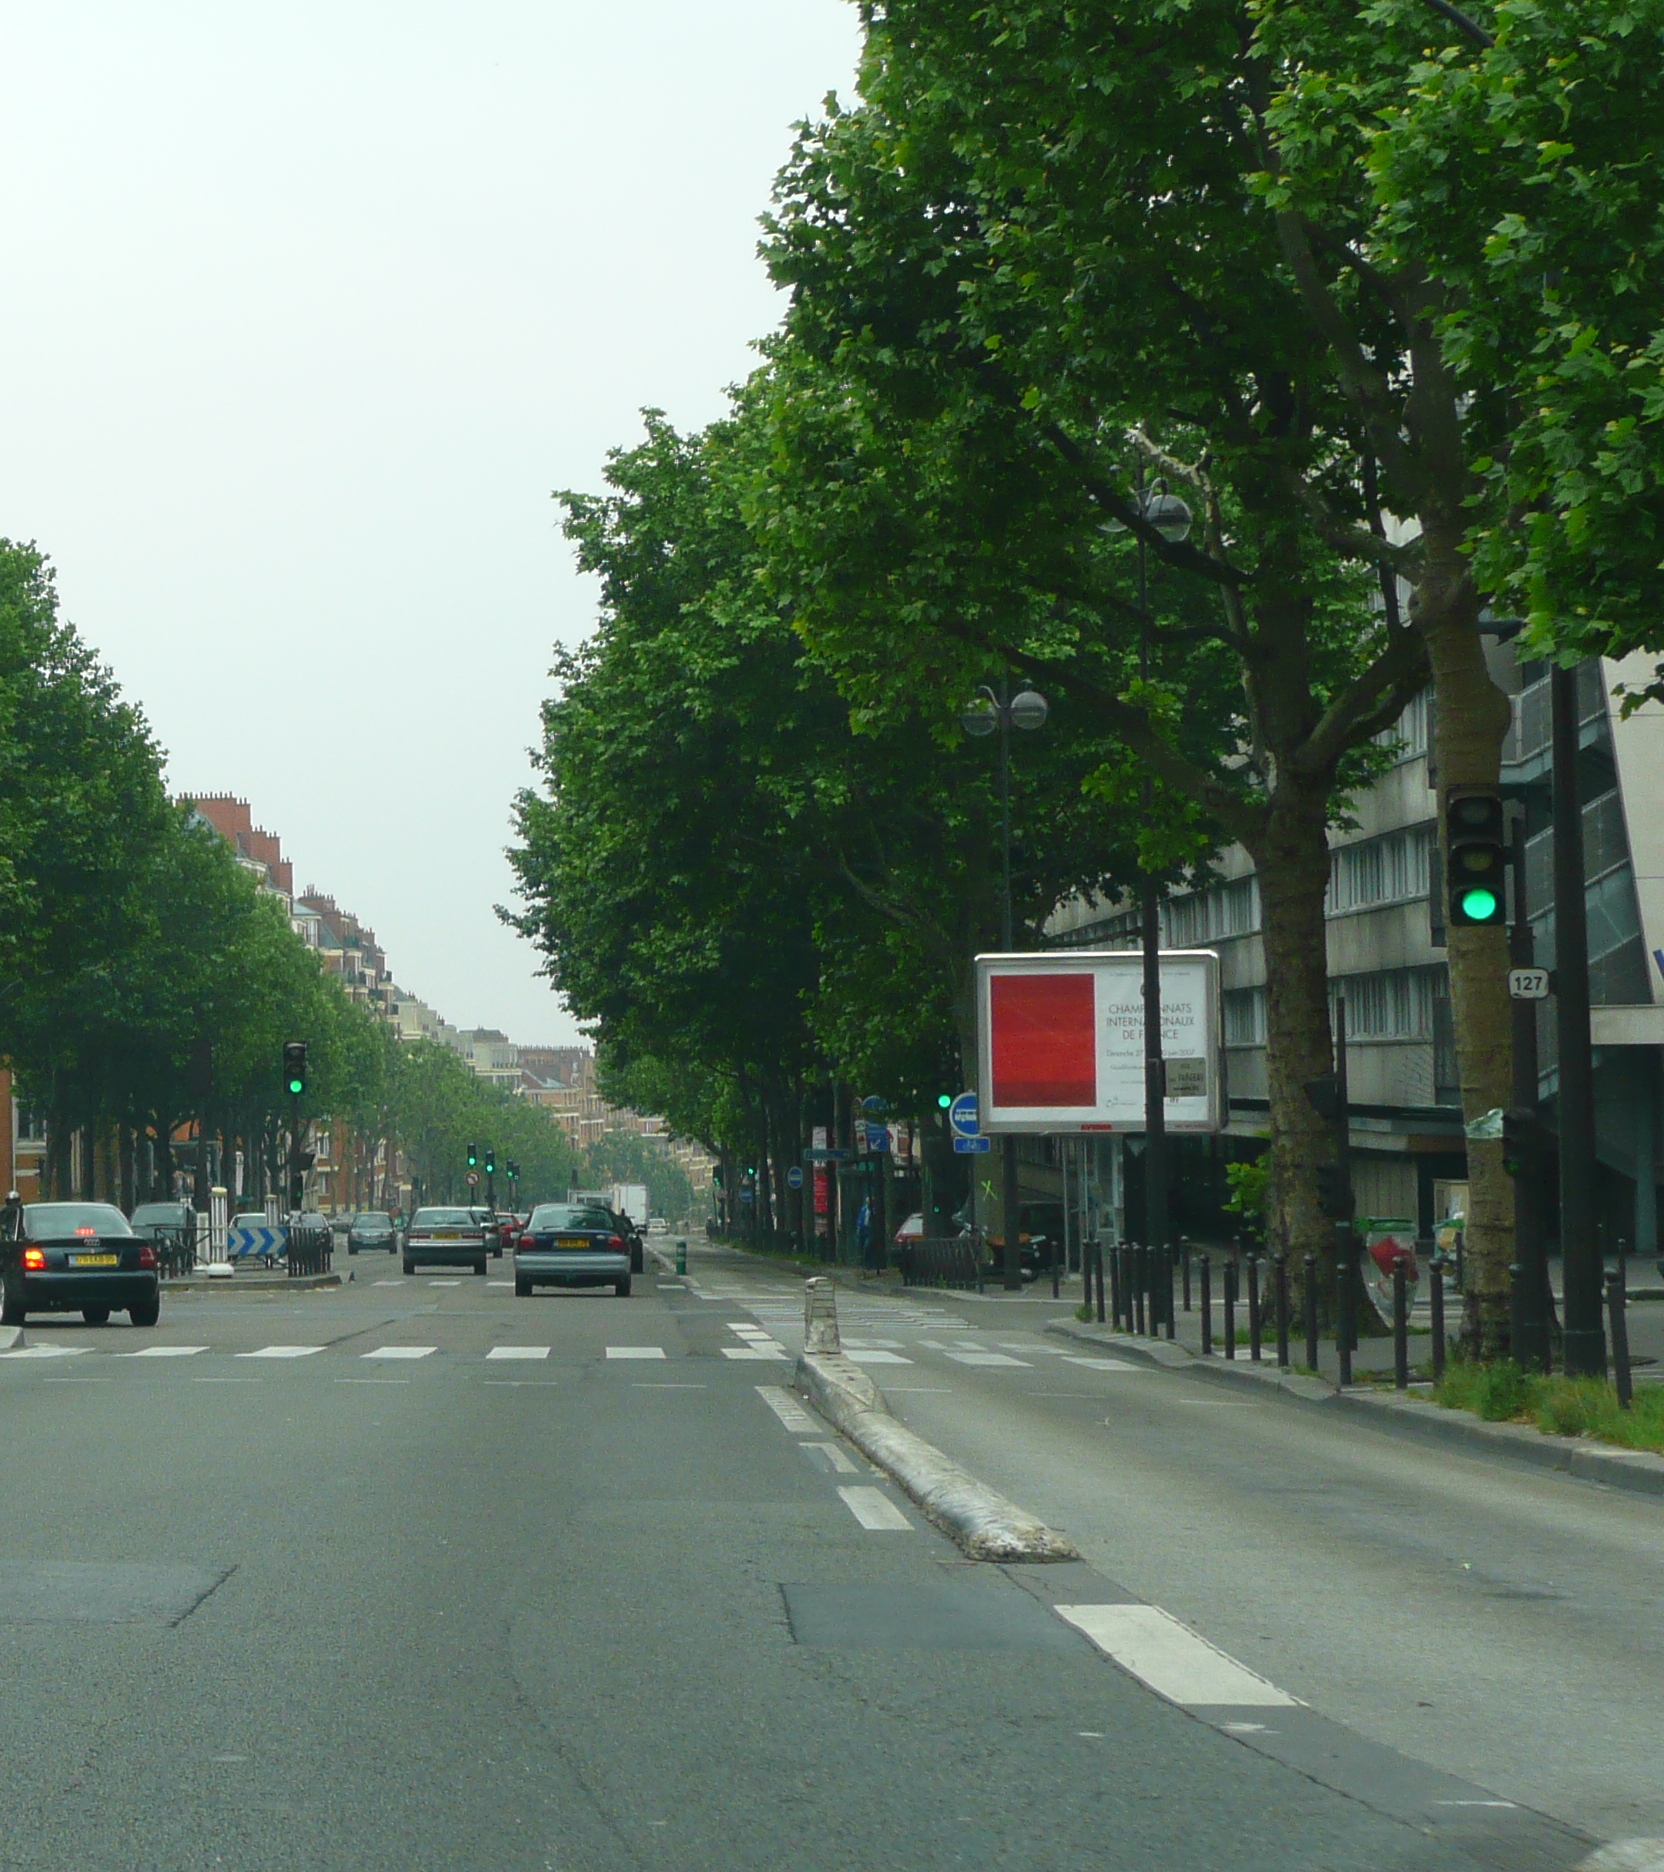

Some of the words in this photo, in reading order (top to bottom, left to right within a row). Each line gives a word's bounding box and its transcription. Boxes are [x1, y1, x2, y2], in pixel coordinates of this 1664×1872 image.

[1515, 976, 1542, 991] 127
[1109, 1003, 1192, 1014] CHAMPNNATS
[1123, 1030, 1135, 1040] DE
[1139, 1030, 1179, 1040] FNCE
